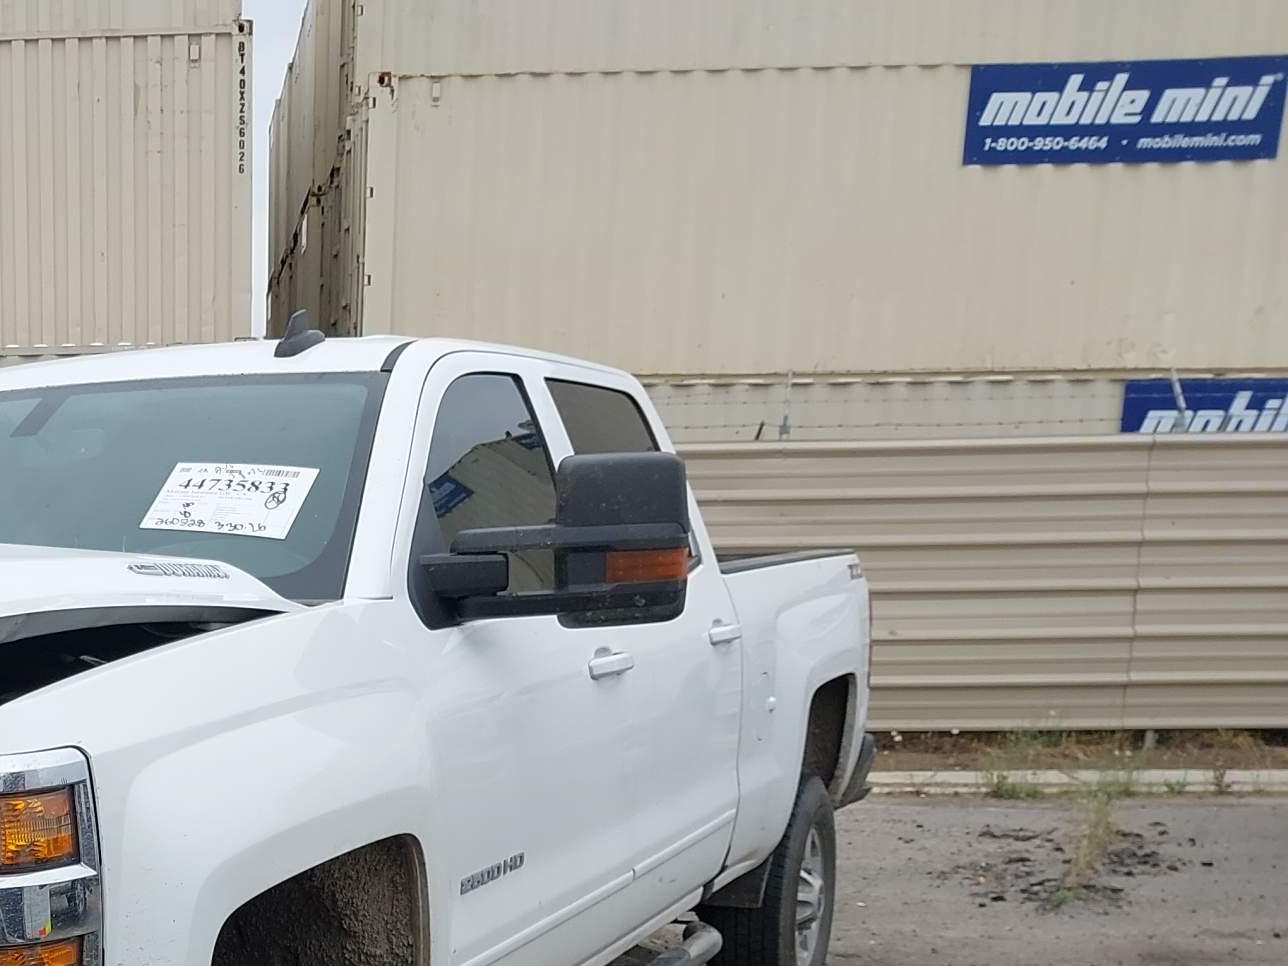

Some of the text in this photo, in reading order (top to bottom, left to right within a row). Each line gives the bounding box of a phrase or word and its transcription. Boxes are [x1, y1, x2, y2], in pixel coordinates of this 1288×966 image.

[978, 72, 1275, 126] mobile mini
[983, 133, 1262, 151] 1-800-950-6464 mobilemini.com
[178, 478, 290, 494] 44735833
